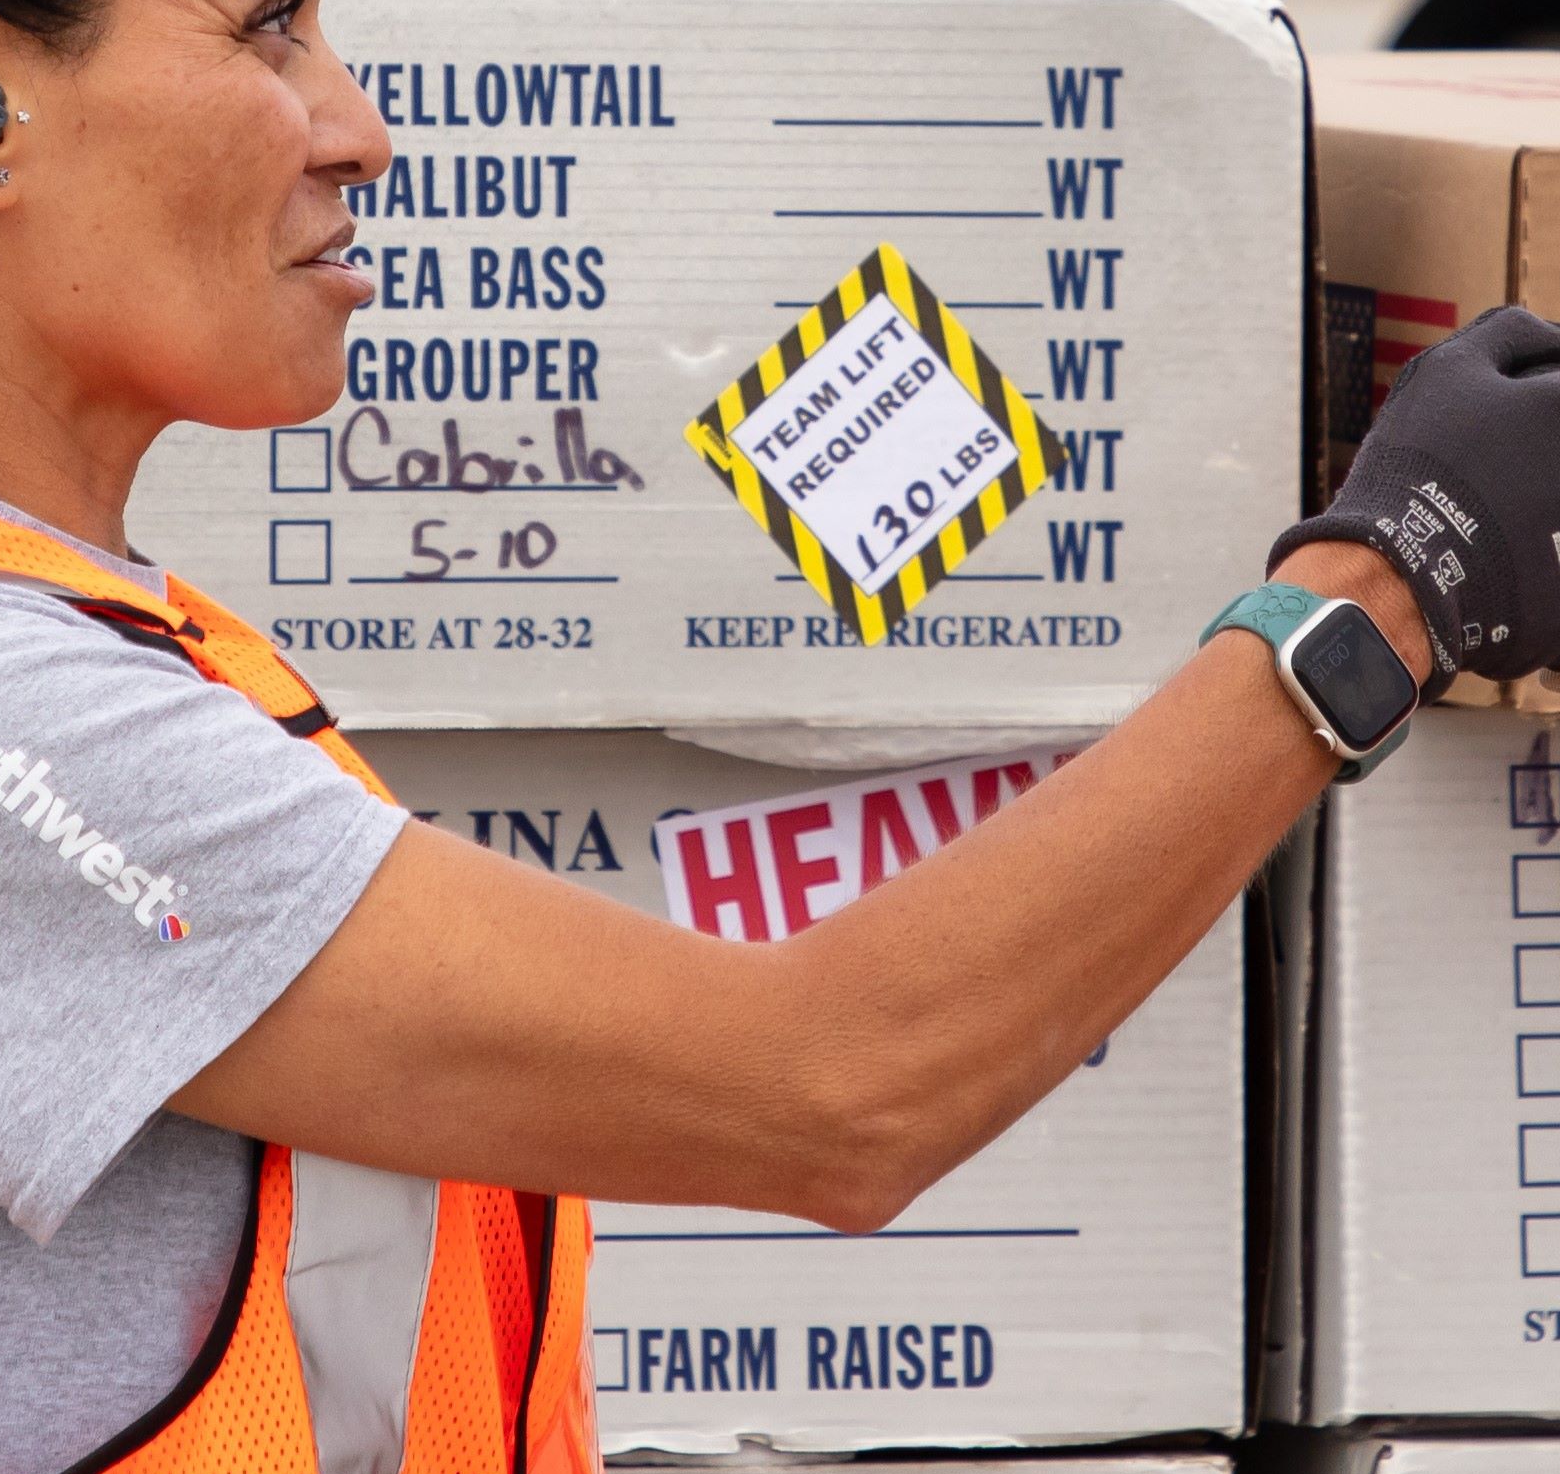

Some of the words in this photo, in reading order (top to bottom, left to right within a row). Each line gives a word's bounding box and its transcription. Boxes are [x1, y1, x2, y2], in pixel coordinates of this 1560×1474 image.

[1046, 67, 1123, 130] WT
[1047, 158, 1123, 220] WT
[470, 246, 606, 311] BASS
[1047, 248, 1124, 311] WT
[347, 337, 599, 402] GROUPER
[1048, 339, 1123, 401] WT
[752, 379, 842, 465] TEAM
[838, 316, 908, 387] LIFT
[786, 355, 938, 501] REQUIRED
[939, 428, 1002, 490] LBS
[856, 480, 938, 575] 130
[1420, 480, 1480, 539] Ansell
[1048, 520, 1123, 583] WT
[272, 618, 415, 651] STORE
[428, 618, 481, 650] AT
[494, 617, 593, 649] 28-32
[686, 616, 795, 648] KEEP
[804, 614, 1125, 650] RERIGERATED
[638, 1327, 777, 1393] FARM
[807, 1324, 993, 1390] RAISED
